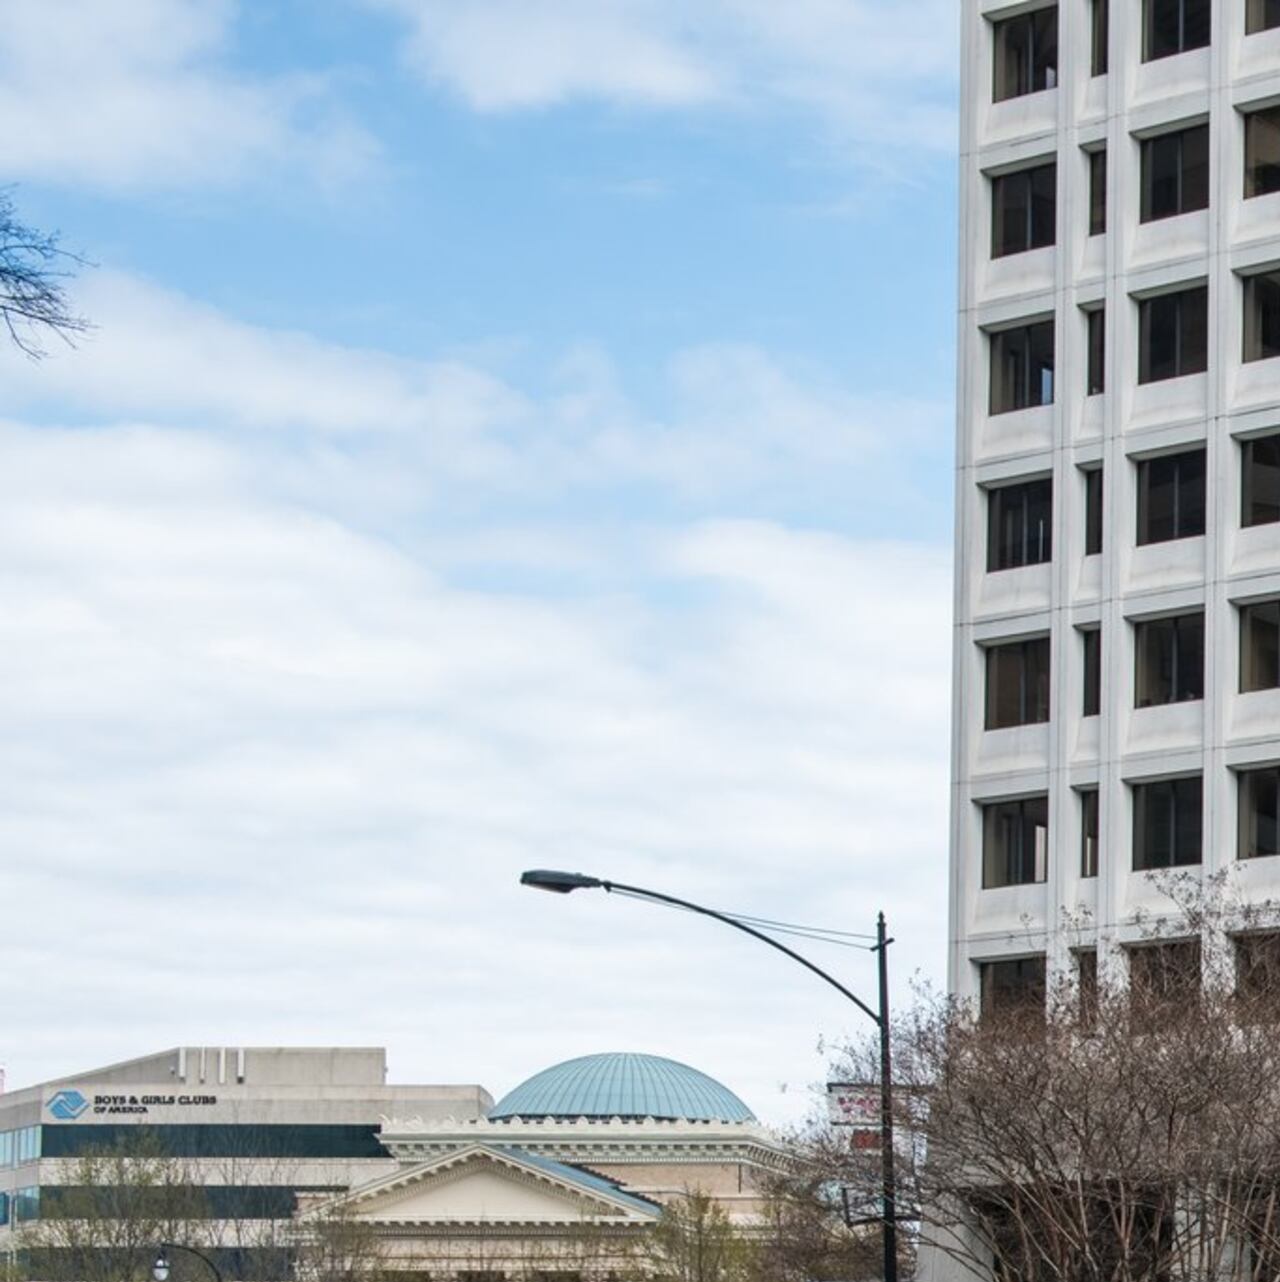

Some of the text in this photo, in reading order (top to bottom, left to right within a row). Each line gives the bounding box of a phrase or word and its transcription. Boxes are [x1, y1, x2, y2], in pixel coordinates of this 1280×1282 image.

[94, 1095, 217, 1106] BOYS & GIRLS CLUBS
[94, 1106, 148, 1114] OF AMERICA
